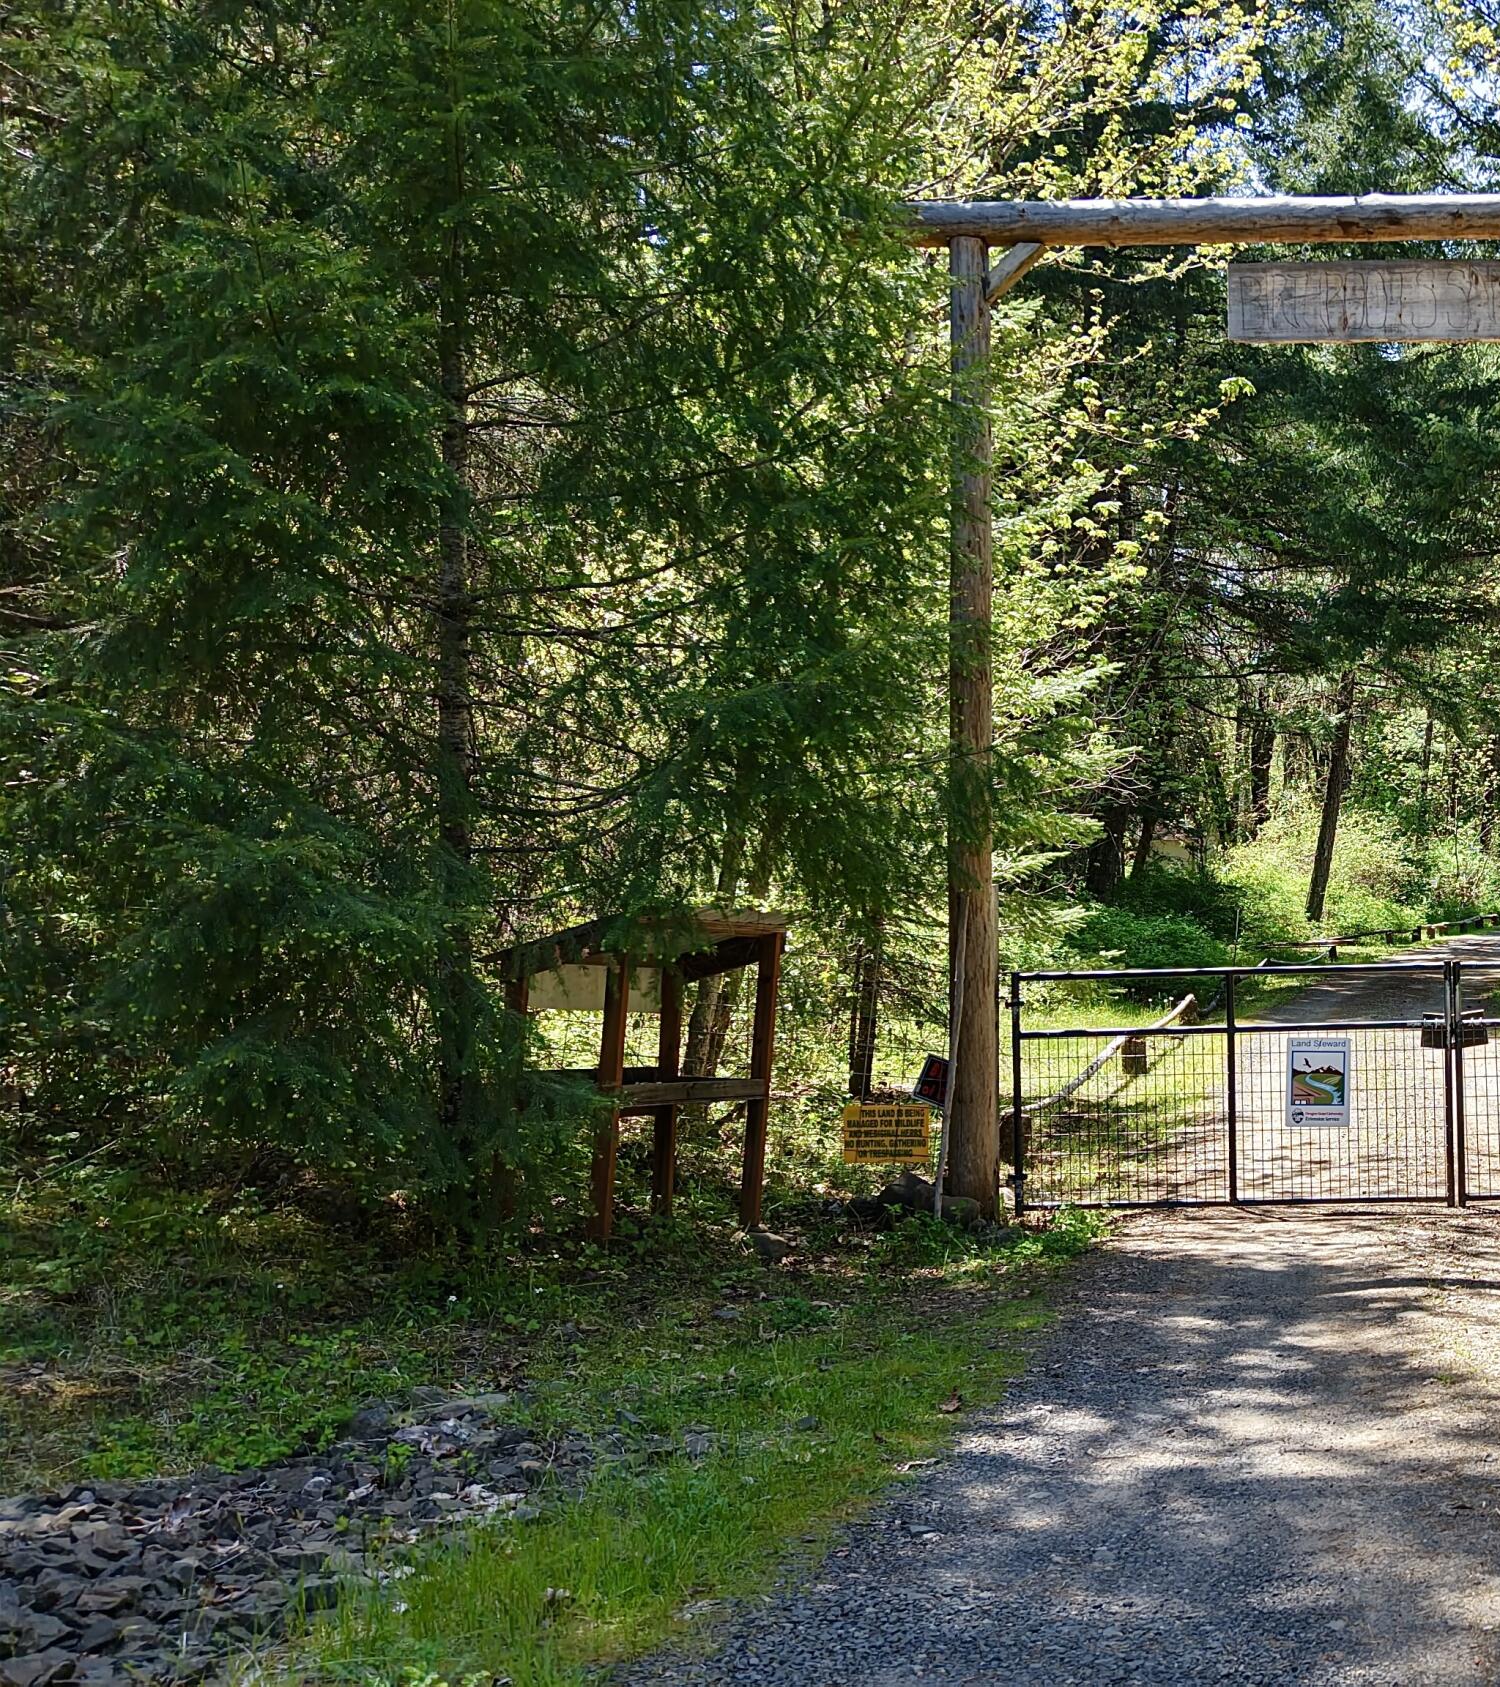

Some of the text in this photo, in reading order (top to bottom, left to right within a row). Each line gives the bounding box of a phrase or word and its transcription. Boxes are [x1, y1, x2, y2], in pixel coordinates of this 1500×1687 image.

[1291, 1039, 1346, 1049] Land Steward
[861, 1109, 925, 1118] THIS LAND IS BEING
[847, 1119, 924, 1127] MANAGED FOR WILDLIFE
[845, 1140, 854, 1148] NO
[889, 1139, 927, 1148] GATHERING
